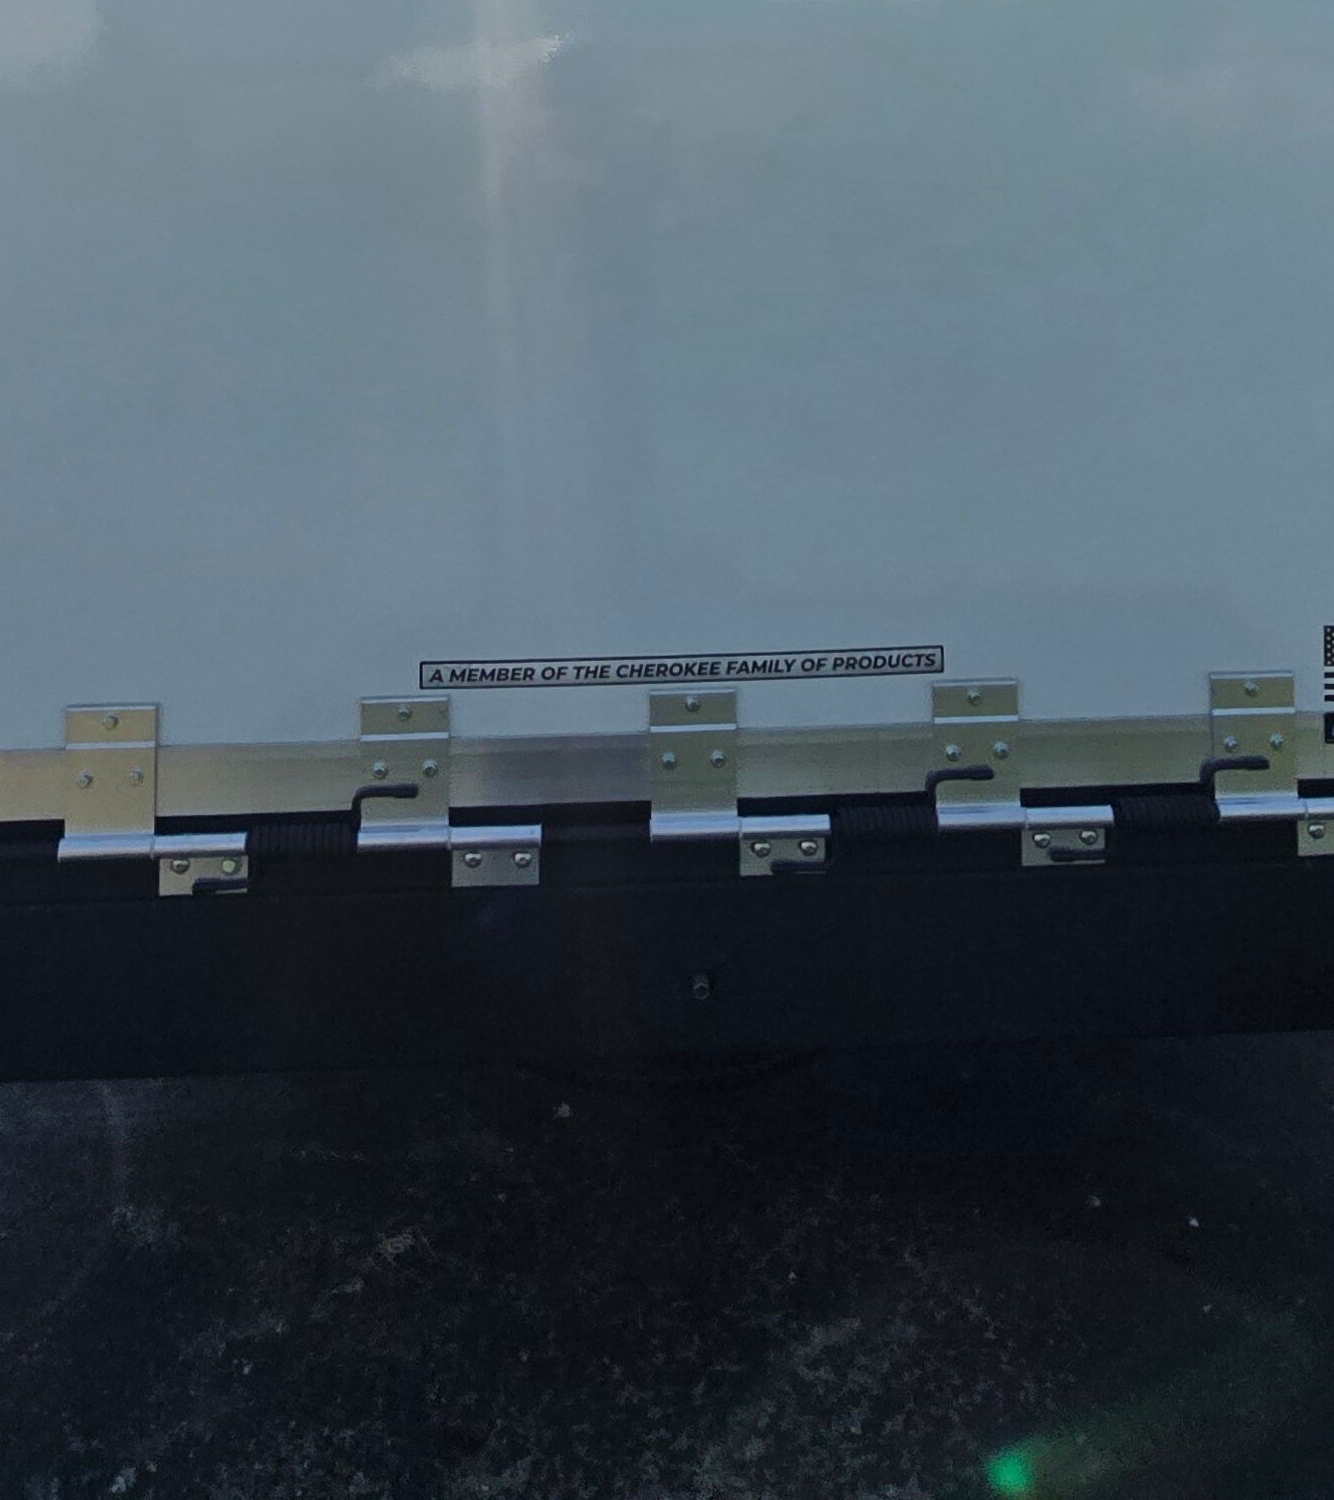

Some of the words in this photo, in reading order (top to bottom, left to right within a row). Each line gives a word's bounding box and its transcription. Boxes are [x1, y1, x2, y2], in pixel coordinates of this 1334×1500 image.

[429, 669, 444, 683] A
[449, 667, 536, 683] MEMBER
[541, 666, 568, 681] OF
[573, 664, 612, 680] THE
[616, 661, 722, 679] CHEROKEE
[725, 659, 797, 676] FAMILY
[800, 657, 829, 672] OF
[832, 653, 937, 672] PRODUCTS
